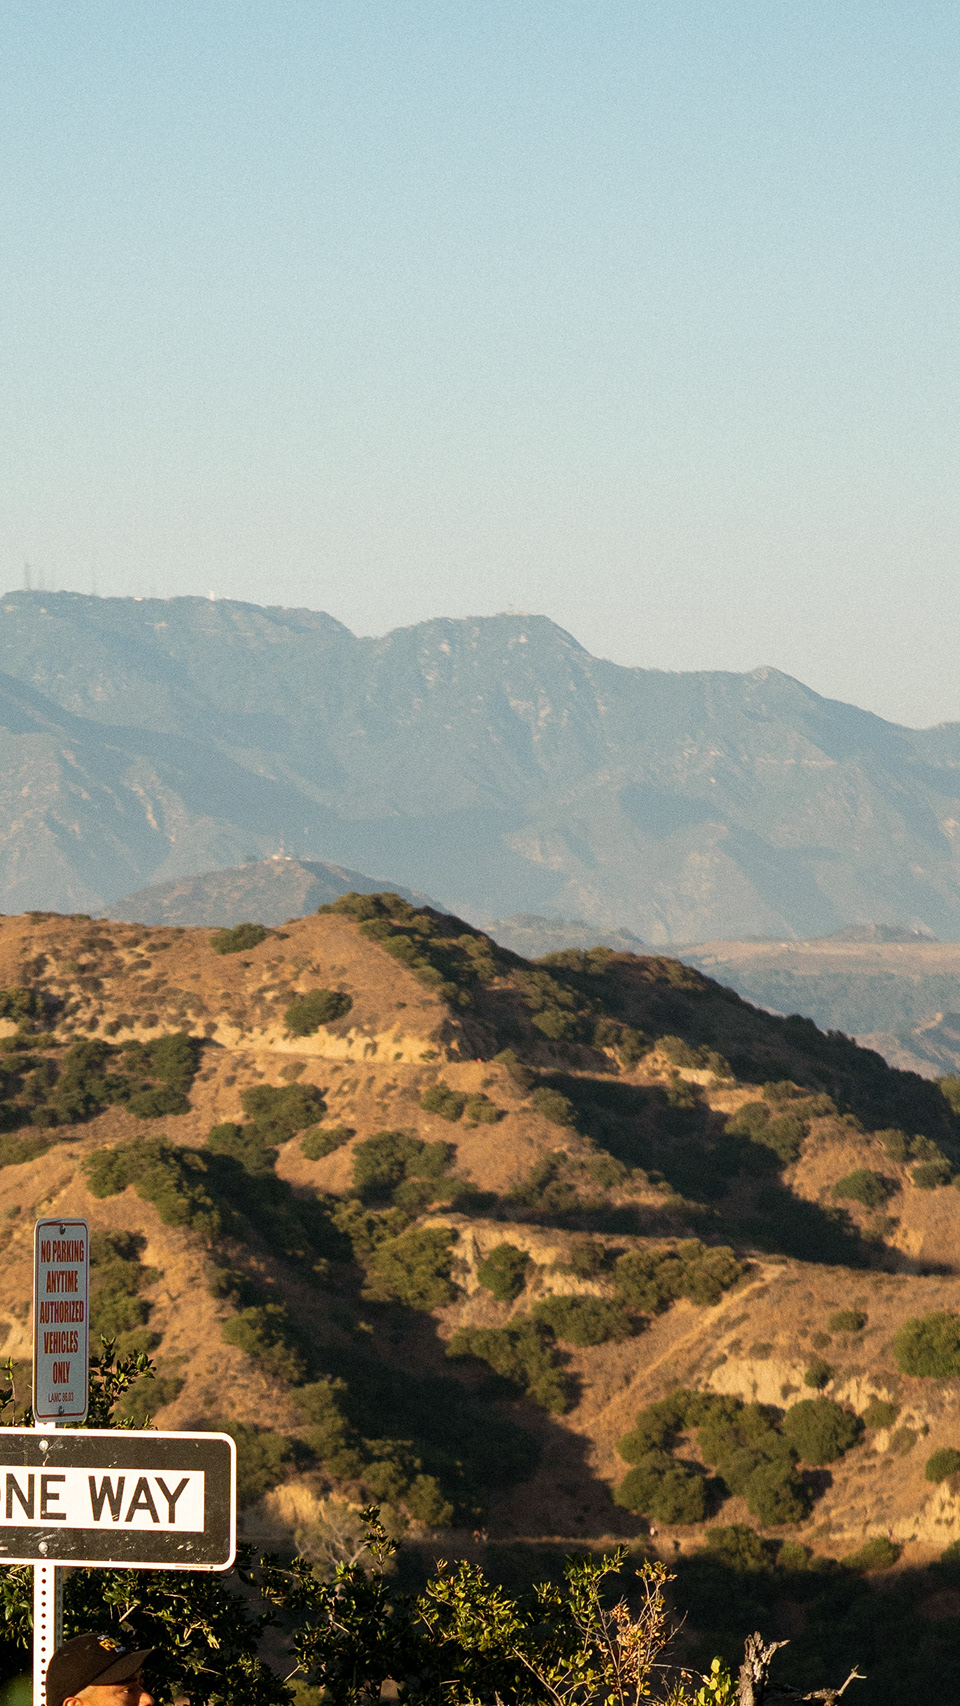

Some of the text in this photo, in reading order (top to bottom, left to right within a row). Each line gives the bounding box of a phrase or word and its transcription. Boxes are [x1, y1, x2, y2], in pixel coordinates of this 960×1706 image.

[41, 1240, 84, 1263] NO PARKING
[46, 1270, 78, 1293] ANYTIME
[40, 1301, 84, 1323] AUTHORIZED
[44, 1330, 78, 1354] VEHICLES
[52, 1361, 70, 1384] ONLY
[48, 1392, 61, 1402] LAMC
[89, 1475, 190, 1524] WAY
